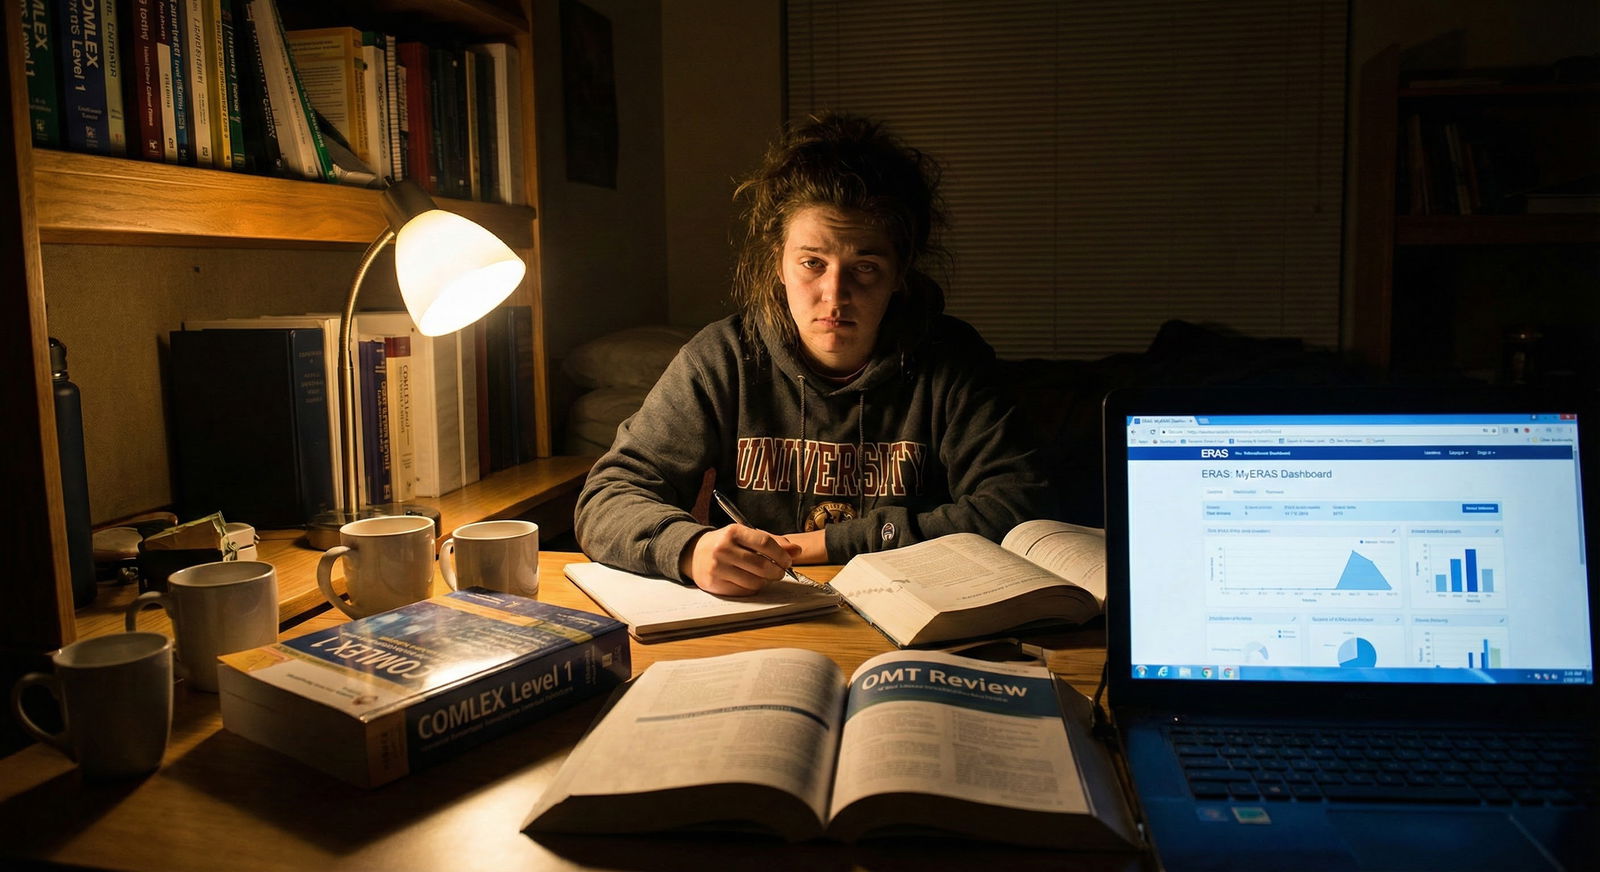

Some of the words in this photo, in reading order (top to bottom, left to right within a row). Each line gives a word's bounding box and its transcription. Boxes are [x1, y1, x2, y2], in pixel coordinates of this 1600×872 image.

[71, 40, 86, 80] Level
[74, 84, 87, 92] 1
[736, 437, 927, 497] UNIVERSITY
[1201, 449, 1229, 458] ERAS
[1201, 469, 1234, 479] ERAS:
[1235, 469, 1279, 480] MyERAS
[1281, 469, 1333, 479] Dashboard
[310, 635, 340, 648] 1
[325, 640, 433, 679] COMLEX
[861, 667, 922, 690] OMT
[929, 668, 1028, 697] Review
[417, 685, 507, 741] COMLEX
[511, 664, 560, 705] Level
[563, 660, 574, 683] 1
